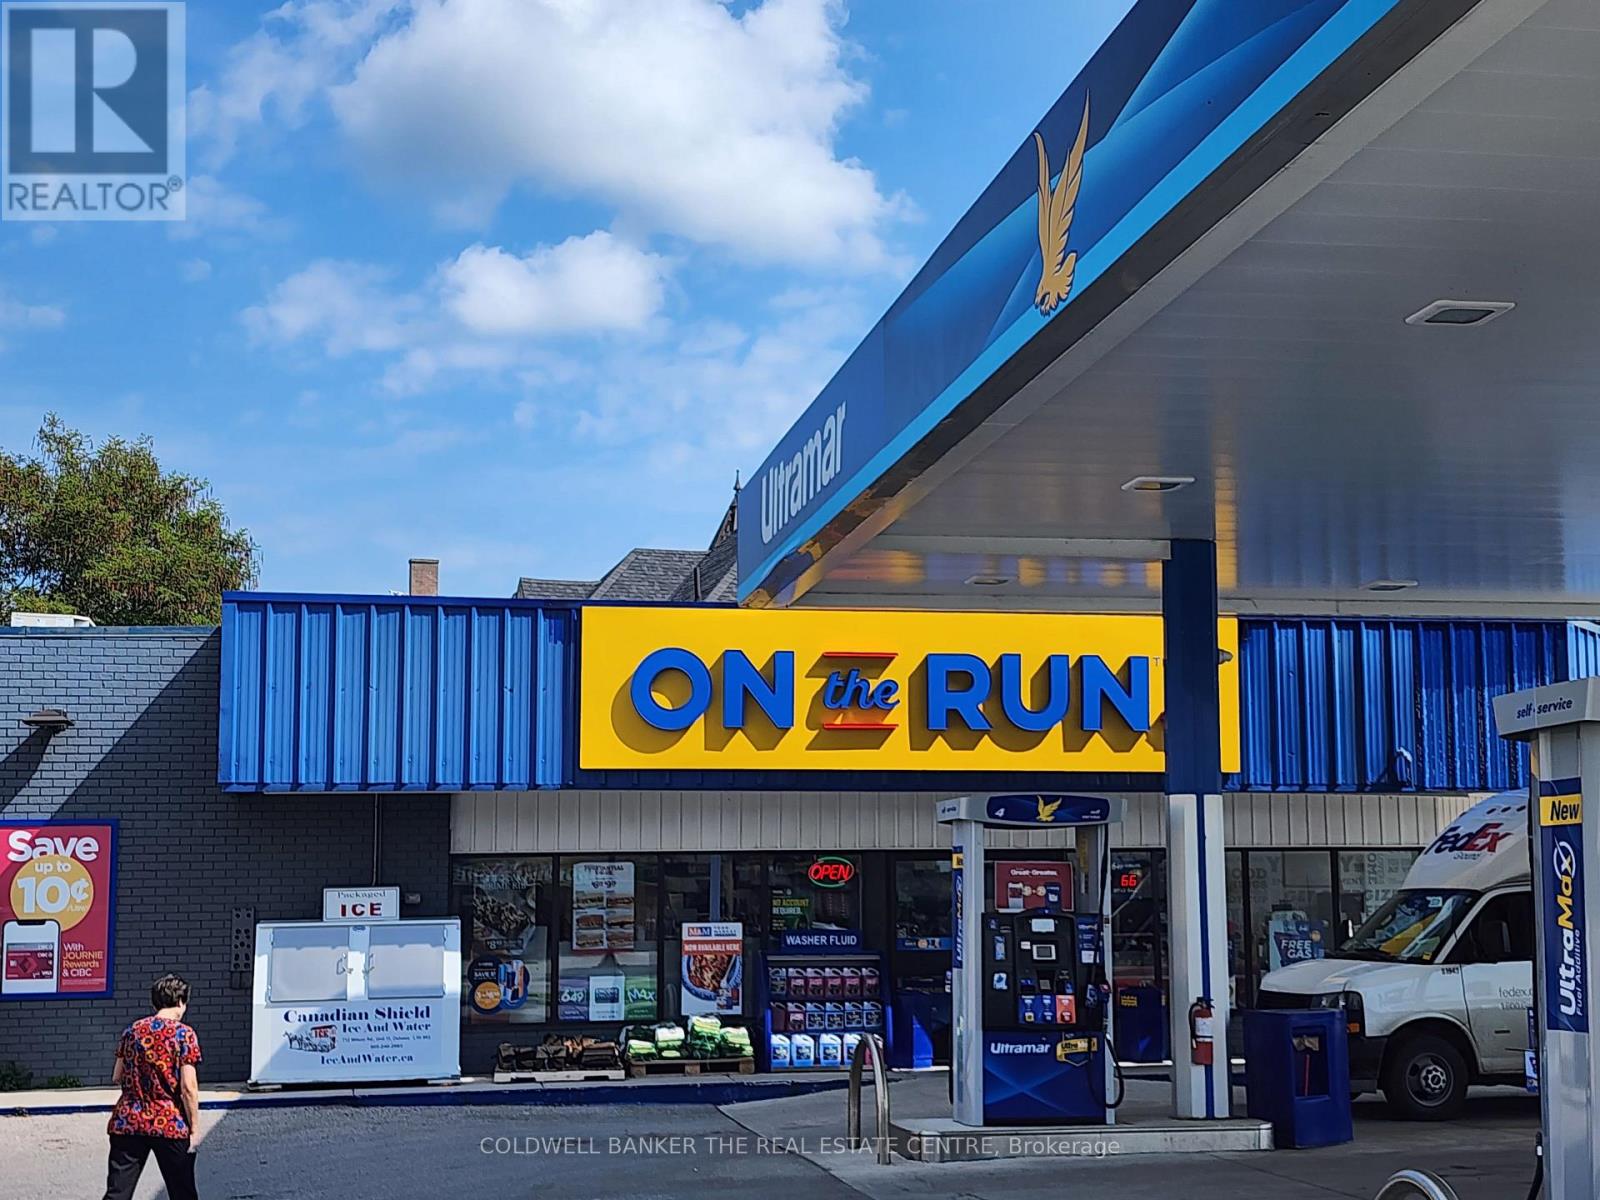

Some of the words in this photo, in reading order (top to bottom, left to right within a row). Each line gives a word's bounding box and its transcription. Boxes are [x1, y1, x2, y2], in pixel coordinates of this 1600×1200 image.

[761, 401, 847, 544] Ultramar
[630, 647, 795, 731] ON
[823, 668, 900, 711] the
[926, 653, 1150, 733] RUN
[995, 808, 1005, 818] 4
[1550, 801, 1580, 821] New
[1424, 822, 1513, 855] FedEx
[7, 829, 100, 862] Save
[34, 862, 53, 875] up
[57, 861, 72, 873] to
[811, 864, 850, 881] OPEN
[1121, 874, 1137, 887] 66
[17, 875, 90, 914] 10¢
[338, 889, 386, 899] Packaged
[341, 902, 382, 918] ICE
[1553, 835, 1576, 1016] UltraMax
[63, 943, 85, 951] With
[786, 935, 828, 946] WASHER
[829, 935, 857, 945] FLUID
[1281, 939, 1312, 950] FREE
[63, 951, 104, 960] JOURNIE
[1287, 950, 1313, 959] GAS
[63, 960, 99, 968] Rewards
[283, 1008, 369, 1023] Canadian
[374, 1005, 431, 1020] Shield
[342, 1023, 361, 1033] Ice
[364, 1022, 388, 1033] And
[392, 1021, 431, 1032] Water
[990, 1042, 1050, 1054] Ultramar
[320, 1054, 414, 1065] IceAndWater.ca
